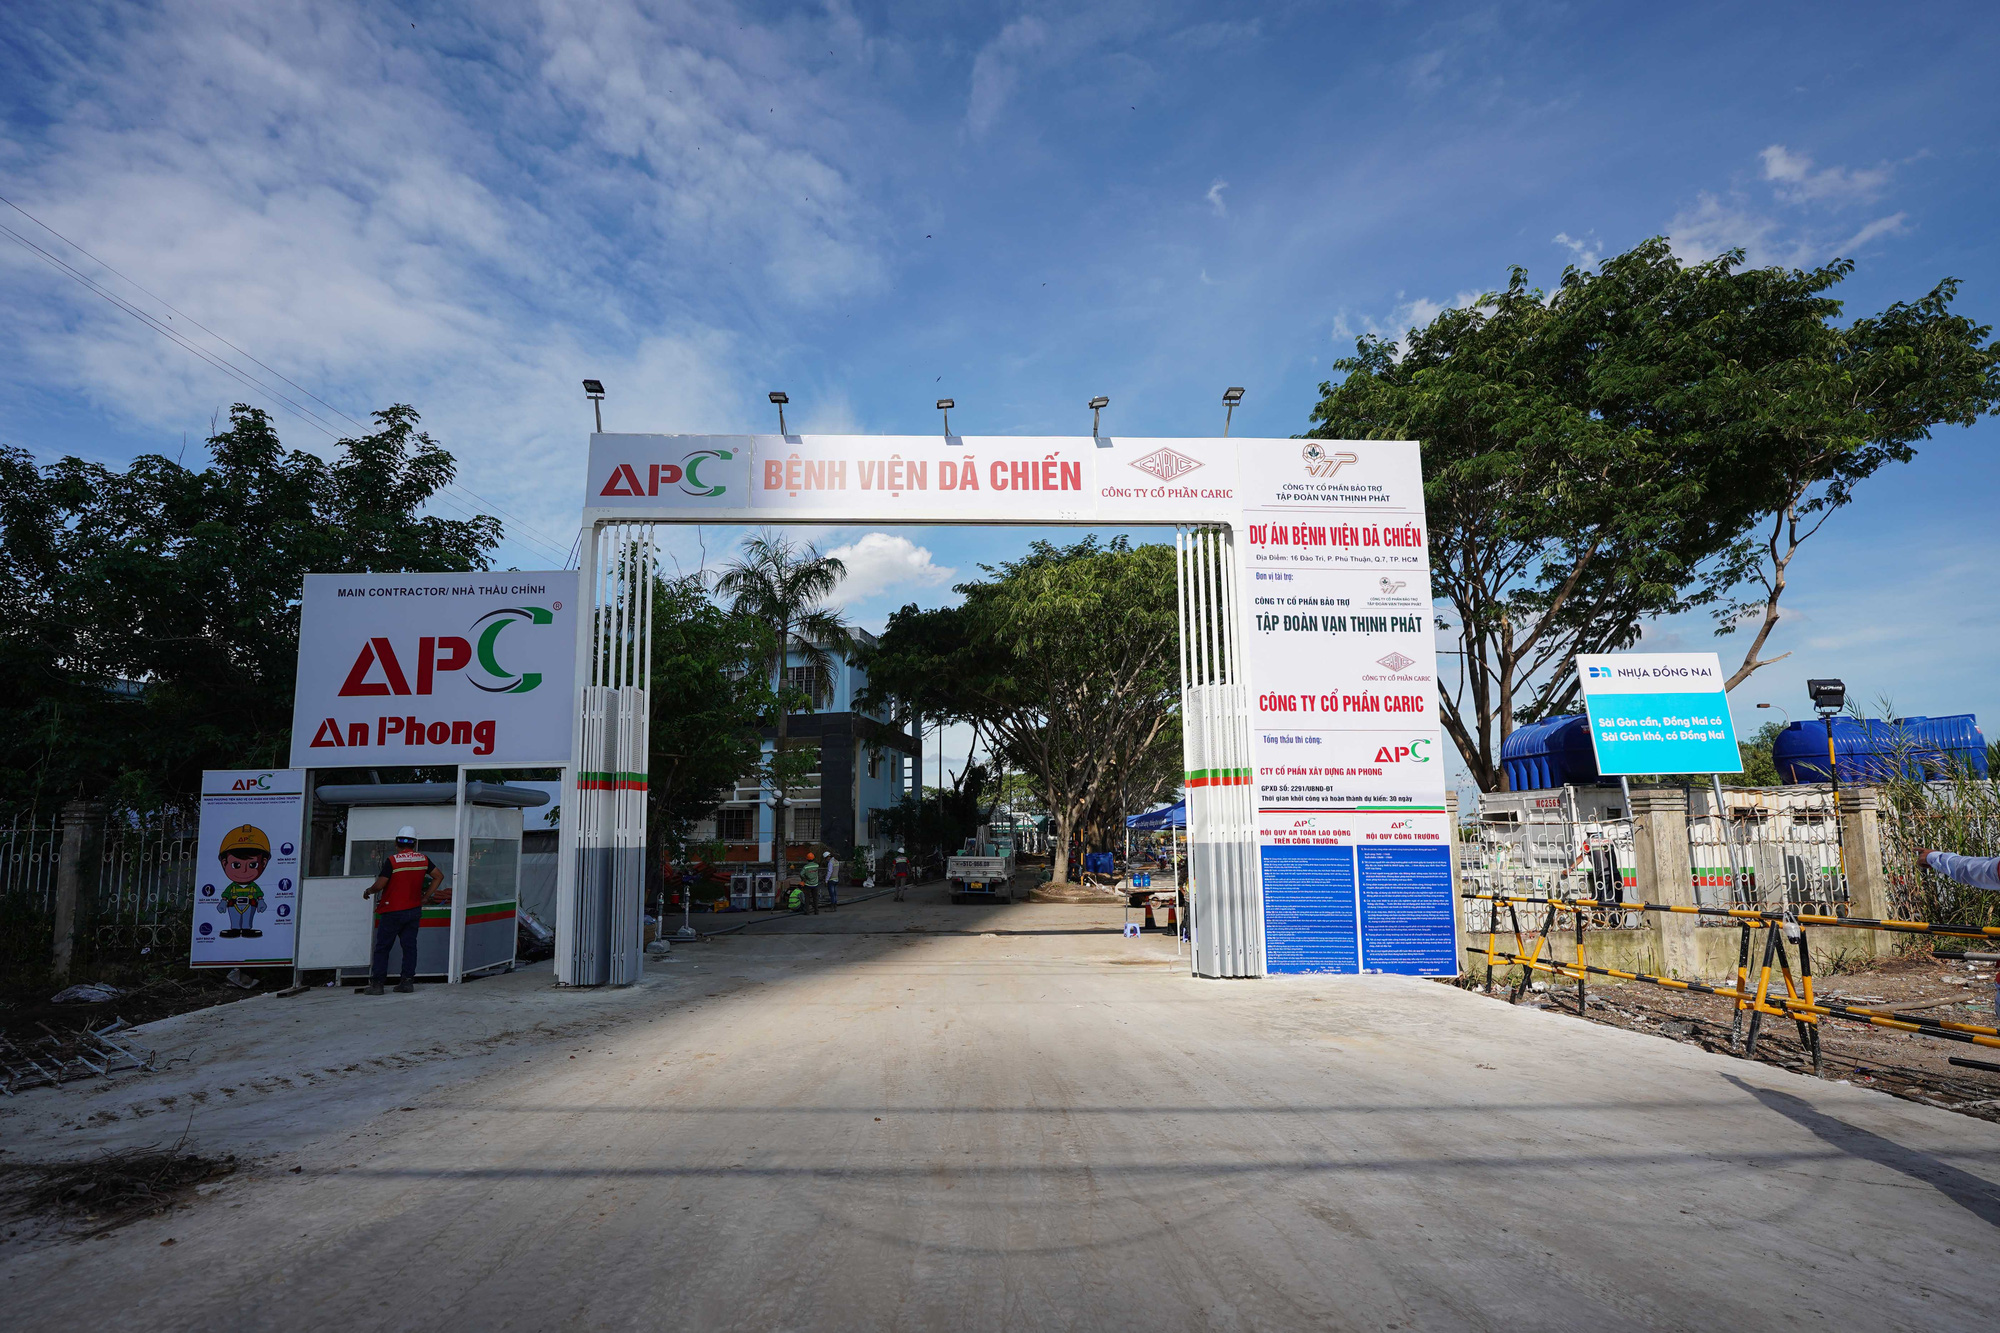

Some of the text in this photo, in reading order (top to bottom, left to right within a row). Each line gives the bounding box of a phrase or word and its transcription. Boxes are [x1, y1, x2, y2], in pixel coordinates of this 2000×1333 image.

[1139, 449, 1192, 480] CARIC
[599, 449, 734, 497] APC
[763, 451, 1082, 498] BỆNH VIỆN DÃ CHIẾN
[1101, 486, 1131, 498] CÔNG
[1133, 488, 1149, 498] TY
[1168, 486, 1198, 498] PHẦN
[1200, 489, 1233, 499] CARIC
[1276, 492, 1390, 504] TẬP ĐOÀN VẠN THỊNH PHÁT
[1250, 521, 1422, 551] DỰ ÁN BỆNH VIỆN DÃ CHIẾN
[337, 584, 545, 597] MAIN CONTRACTOR/ NHÀ THẦU CHÍNH
[1255, 596, 1275, 605] CÔNG
[1255, 611, 1422, 636] TẬP ĐOÀN VẠN THỊNH PHÁT
[337, 606, 553, 697] APC
[1362, 674, 1378, 682] CÔNG
[1617, 665, 1712, 680] NHỰA ĐỒNG NAI
[1259, 688, 1424, 713] CÔNG TY CỔ PHẦN CARIC
[1598, 715, 1722, 728] Sài Gòn cần, Đồng Nai có
[309, 716, 496, 756] An Phong
[1601, 729, 1725, 742] Sài Gòn khó, có Đồng Nai
[1374, 738, 1431, 763] APC
[1260, 767, 1273, 776] CTY
[1324, 767, 1344, 778] DỰNG
[1346, 768, 1357, 776] AN
[1358, 768, 1383, 776] PHONG
[231, 773, 273, 791] APC
[1535, 798, 1560, 808] WC2569
[1293, 817, 1316, 828] APC
[1391, 819, 1413, 829] APC
[1260, 829, 1272, 837] NỘI
[1273, 829, 1287, 837] QUY
[1332, 829, 1351, 837] ĐỘNG
[1366, 832, 1378, 841] NỘI
[1394, 832, 1412, 840] CÔNG
